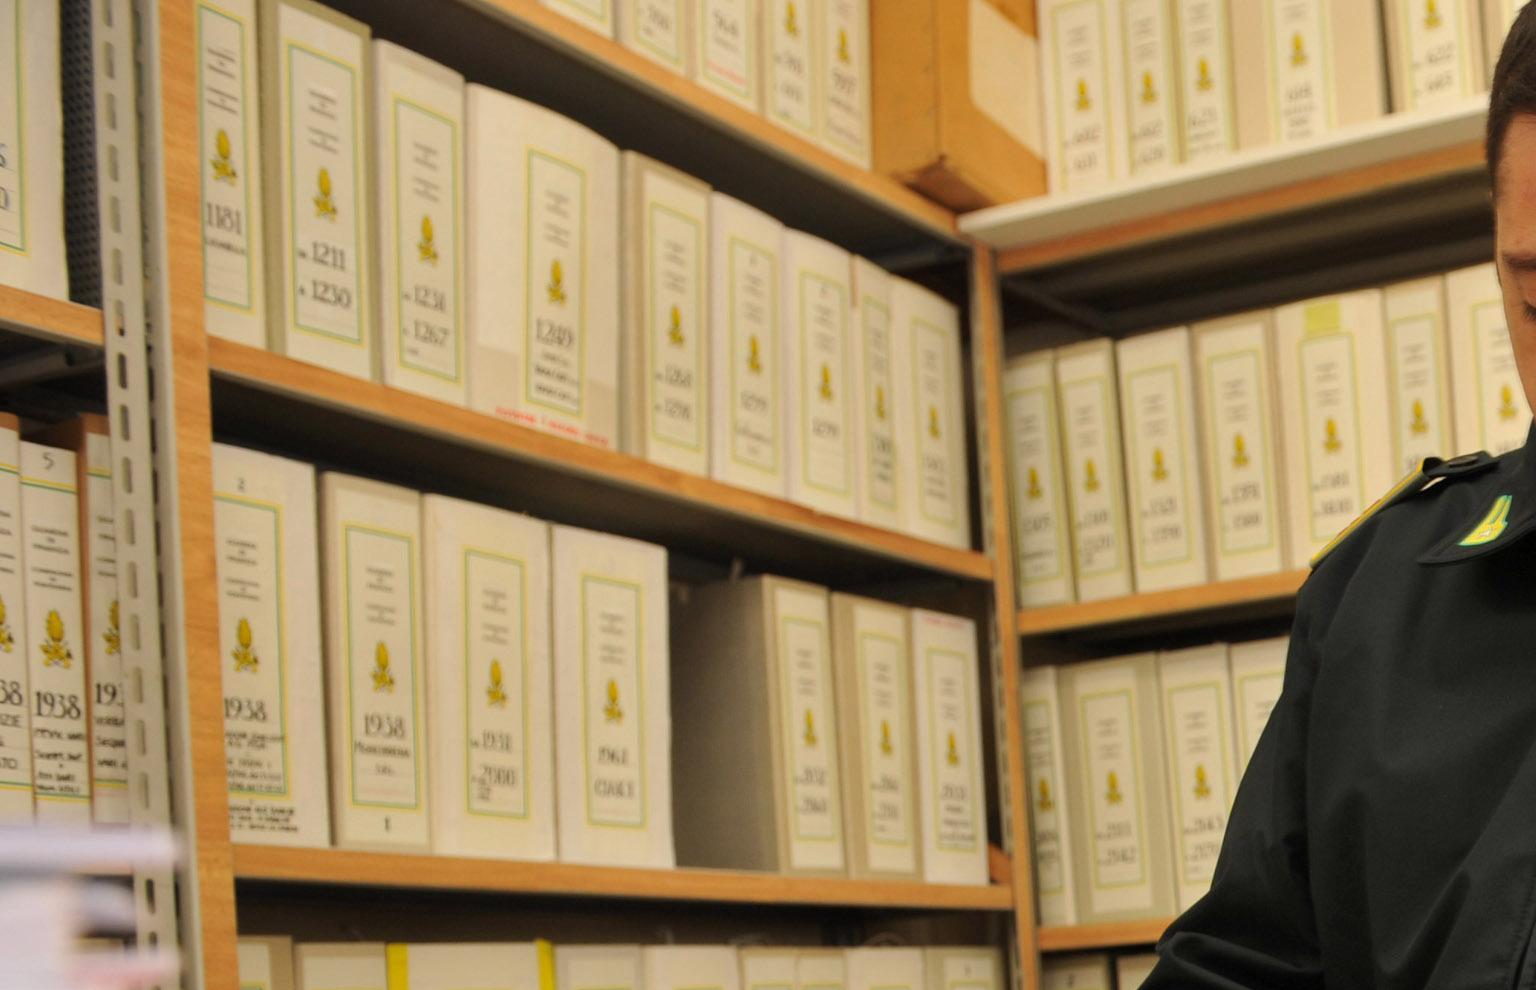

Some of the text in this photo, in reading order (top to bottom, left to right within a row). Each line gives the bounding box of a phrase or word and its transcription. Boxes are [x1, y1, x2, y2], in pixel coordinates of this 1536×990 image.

[36, 690, 82, 720] 1938
[223, 697, 268, 721] 1938
[364, 713, 406, 739] 1938
